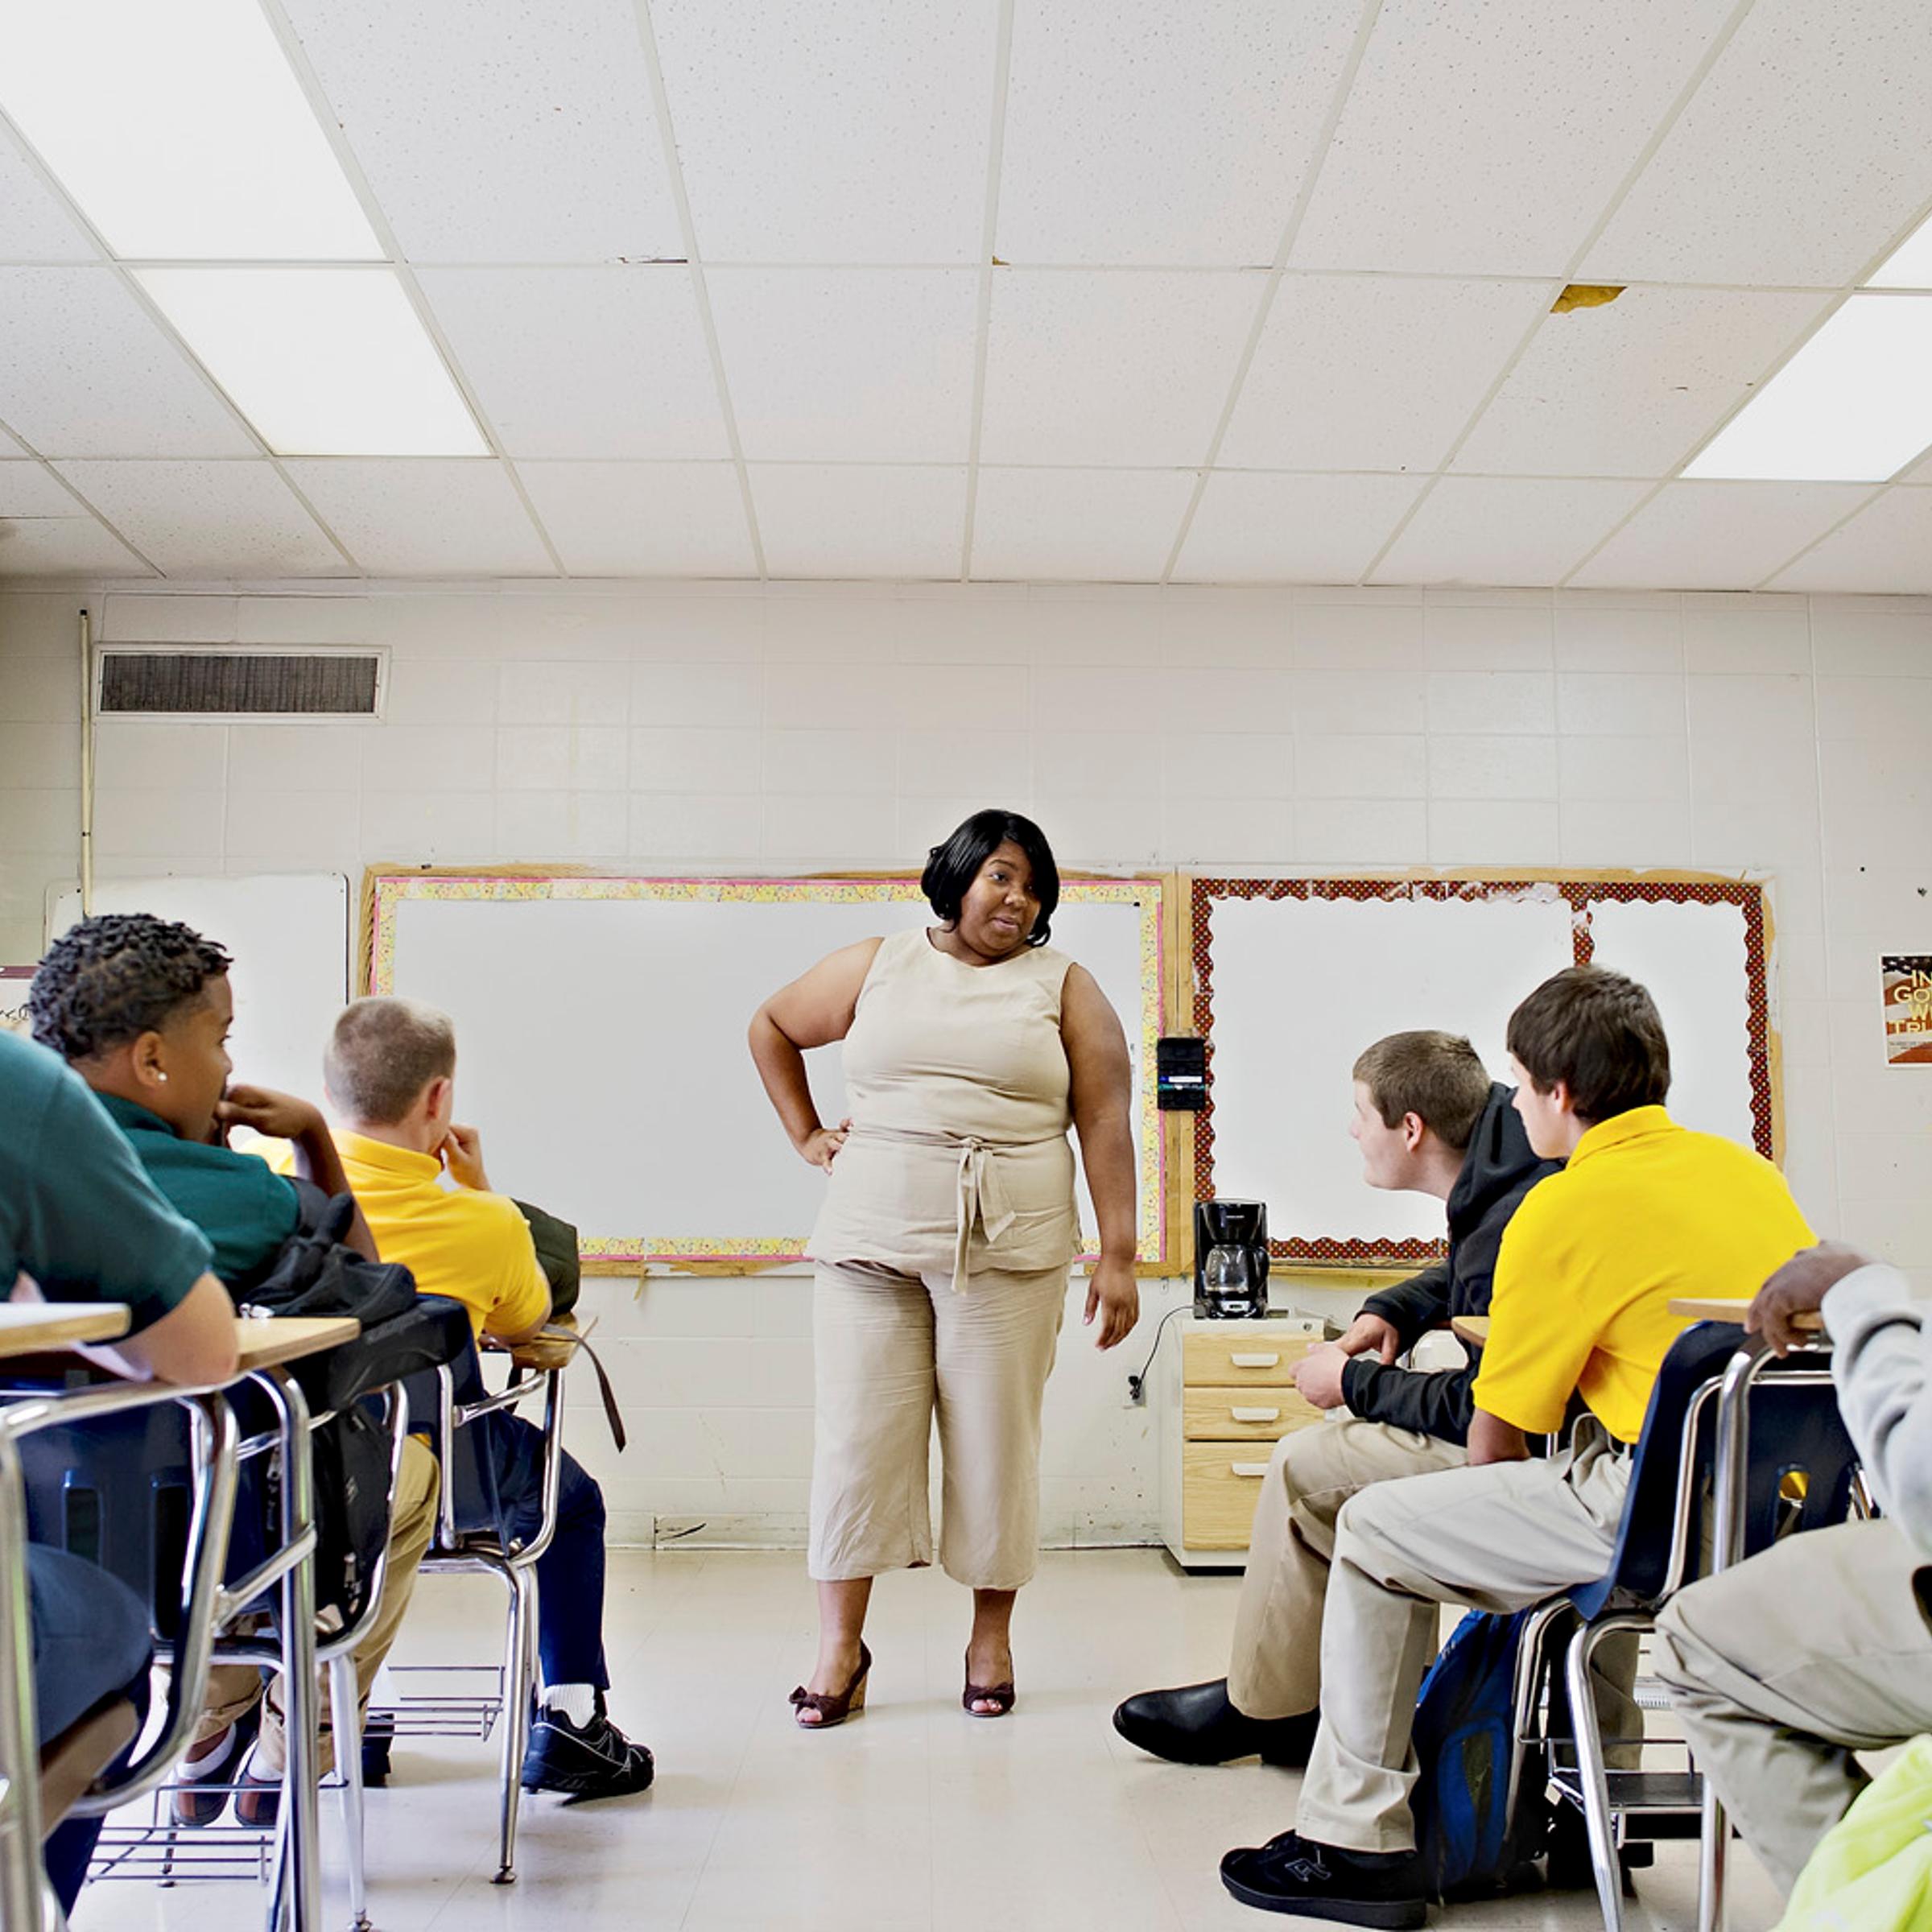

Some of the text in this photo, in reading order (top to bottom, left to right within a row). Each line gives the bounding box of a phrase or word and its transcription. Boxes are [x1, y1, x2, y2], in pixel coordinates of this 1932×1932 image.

[1911, 969, 1932, 988] IN
[1894, 985, 1932, 1003] GO
[1908, 1004, 1932, 1021] W
